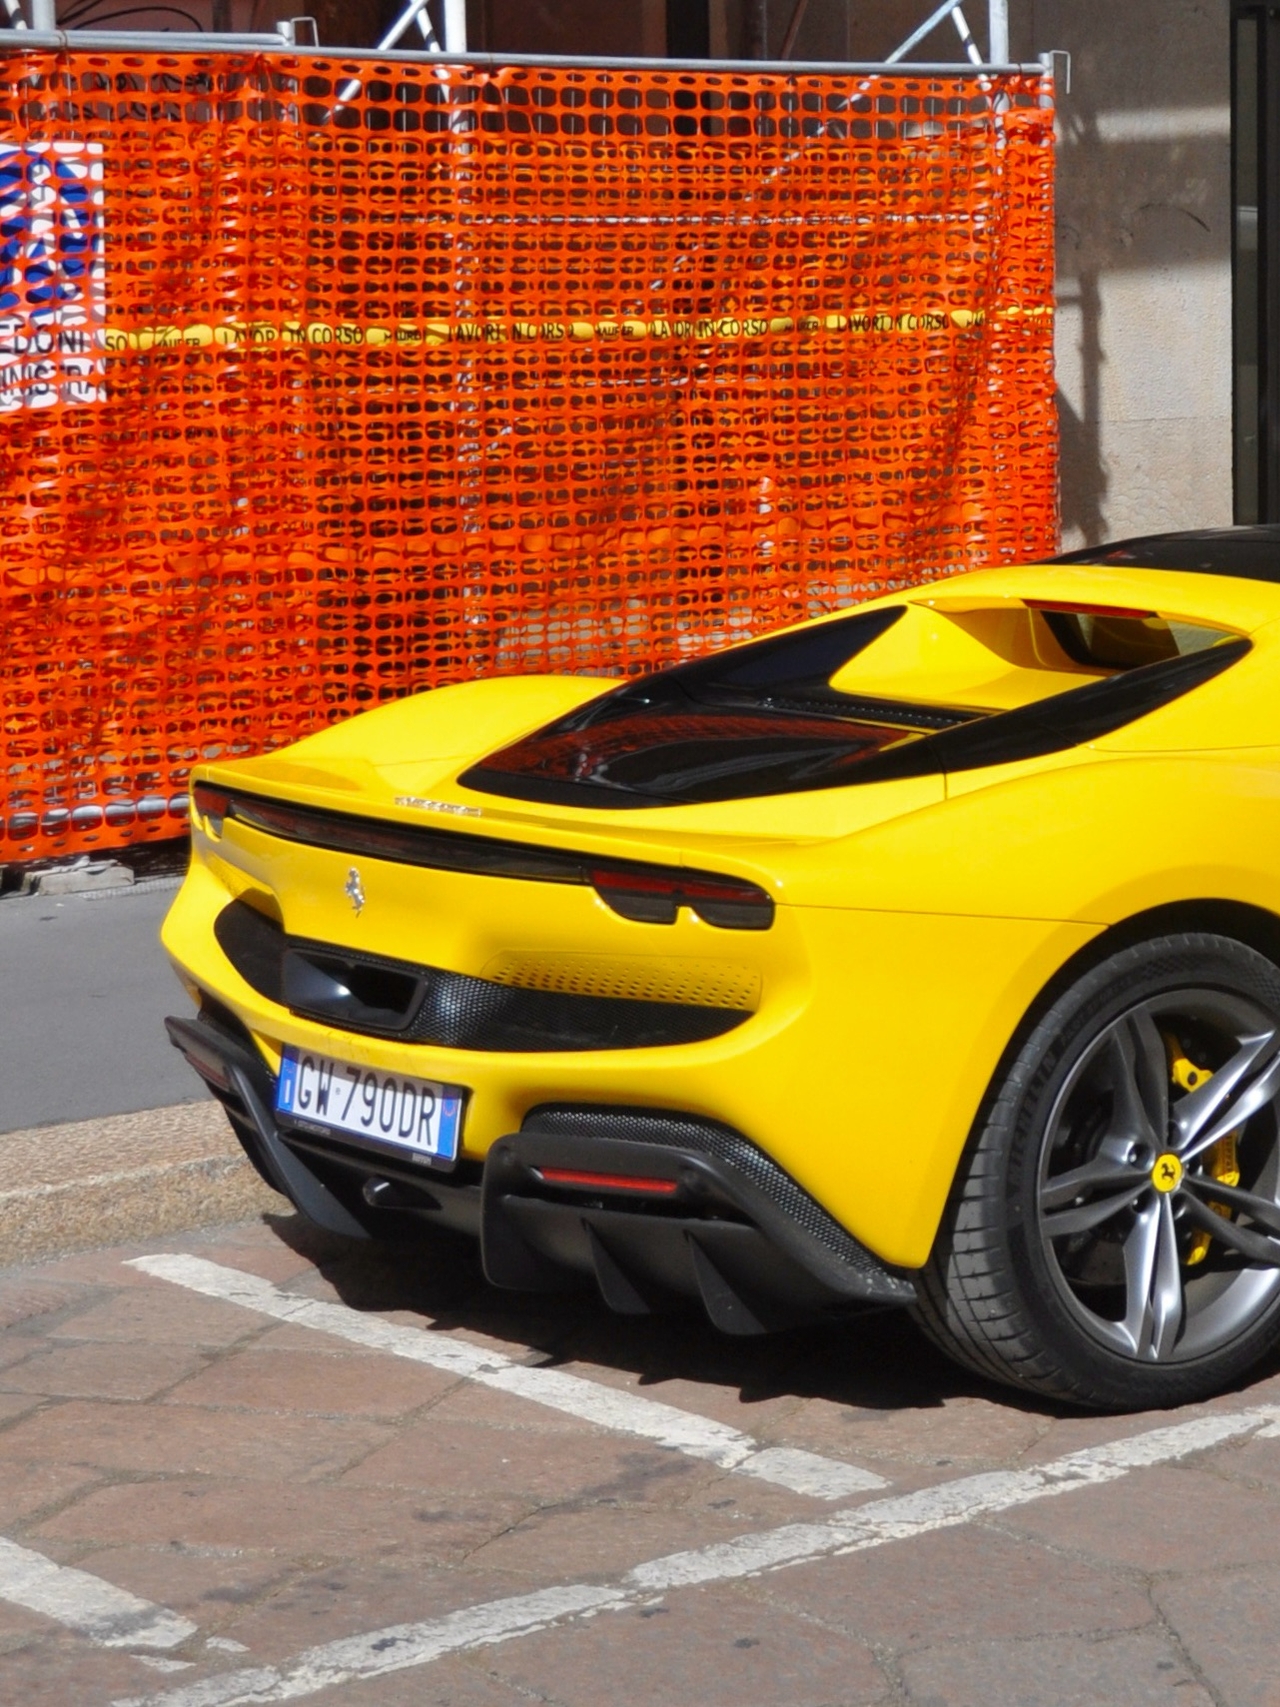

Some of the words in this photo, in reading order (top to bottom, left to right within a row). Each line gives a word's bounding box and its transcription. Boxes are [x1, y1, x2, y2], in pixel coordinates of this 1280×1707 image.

[313, 325, 363, 344] CORSO
[719, 318, 768, 337] CORSO
[299, 1056, 334, 1116] GW
[341, 1066, 436, 1146] 790DR
